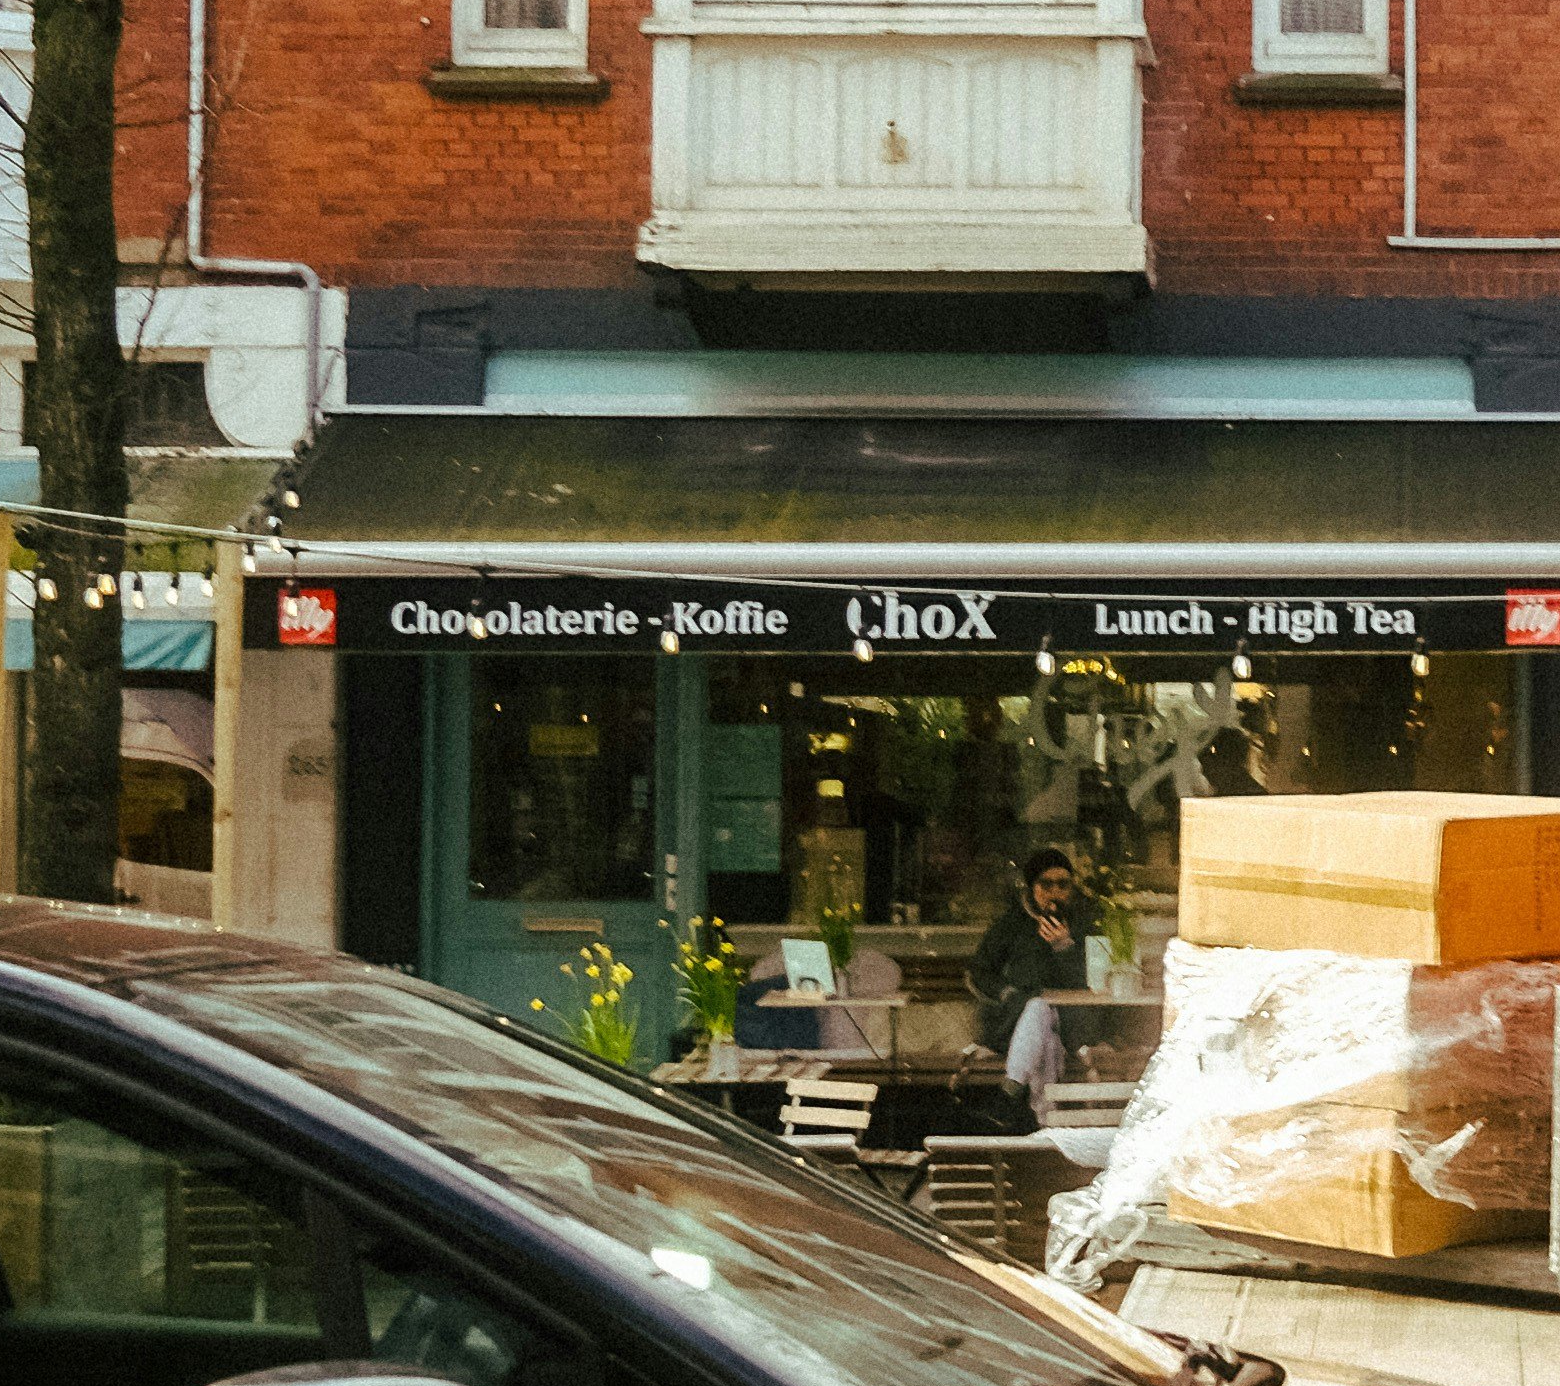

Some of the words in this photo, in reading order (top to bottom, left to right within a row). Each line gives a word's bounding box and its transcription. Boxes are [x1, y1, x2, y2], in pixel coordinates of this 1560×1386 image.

[672, 600, 789, 635] Koffie
[1095, 602, 1215, 635] Lunch
[1247, 601, 1338, 644] High
[1346, 601, 1416, 635] Tea
